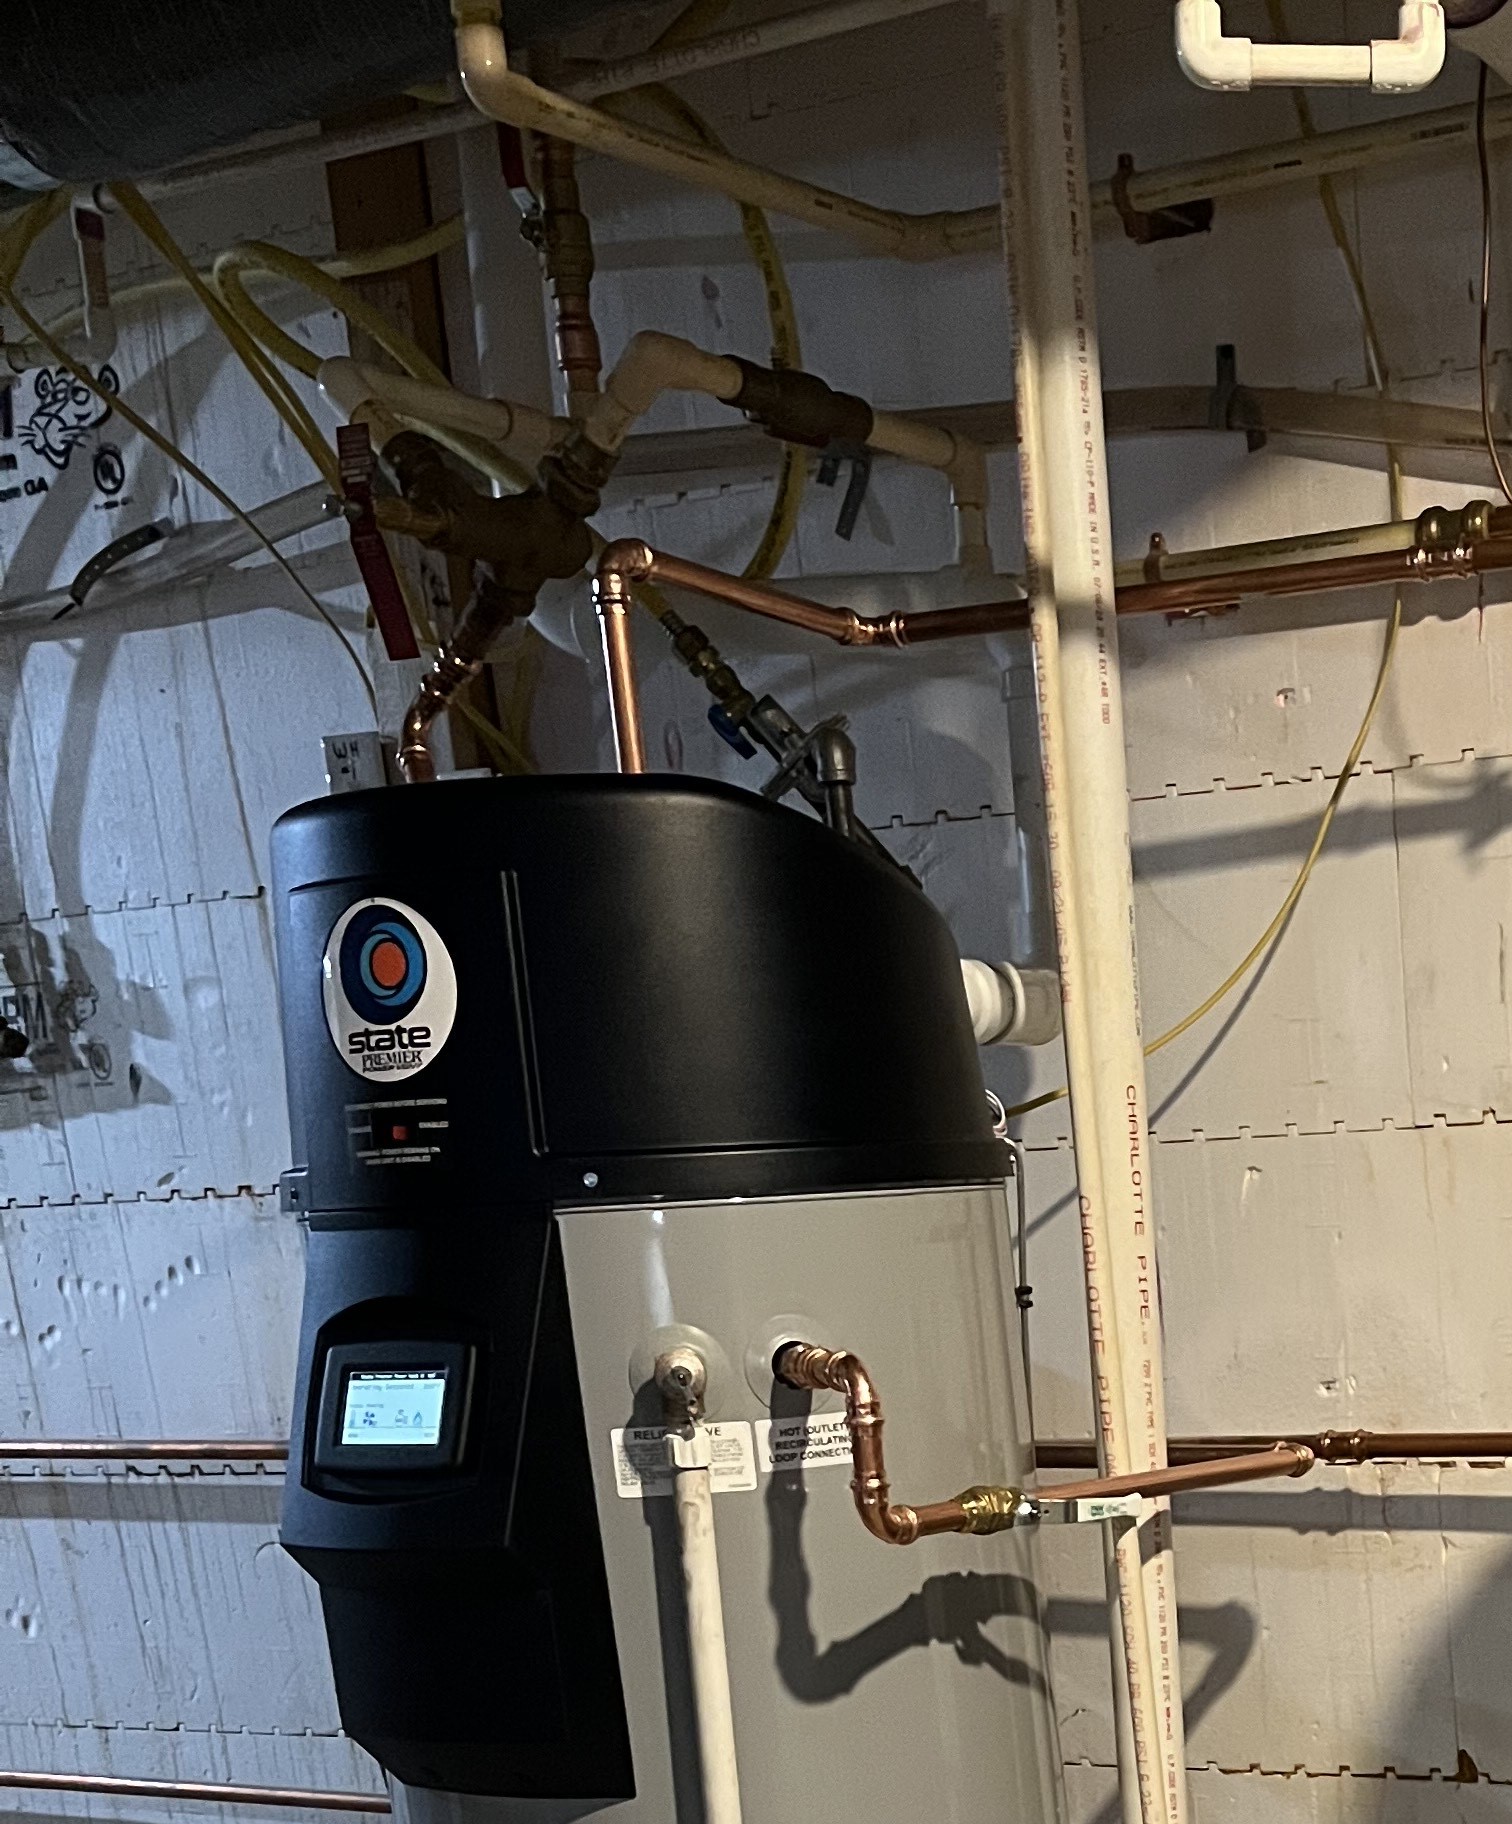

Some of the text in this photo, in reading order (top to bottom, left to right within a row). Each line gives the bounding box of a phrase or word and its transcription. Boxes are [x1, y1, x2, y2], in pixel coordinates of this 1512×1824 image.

[349, 1024, 431, 1055] state
[362, 1050, 423, 1068] PREMIER
[1126, 1084, 1151, 1320] CHARLOTTE PIPE
[1081, 1195, 1116, 1443] CHARLOTTE PIPE
[779, 1427, 801, 1437] HOT
[769, 1447, 852, 1464] LOOP CONNECTI
